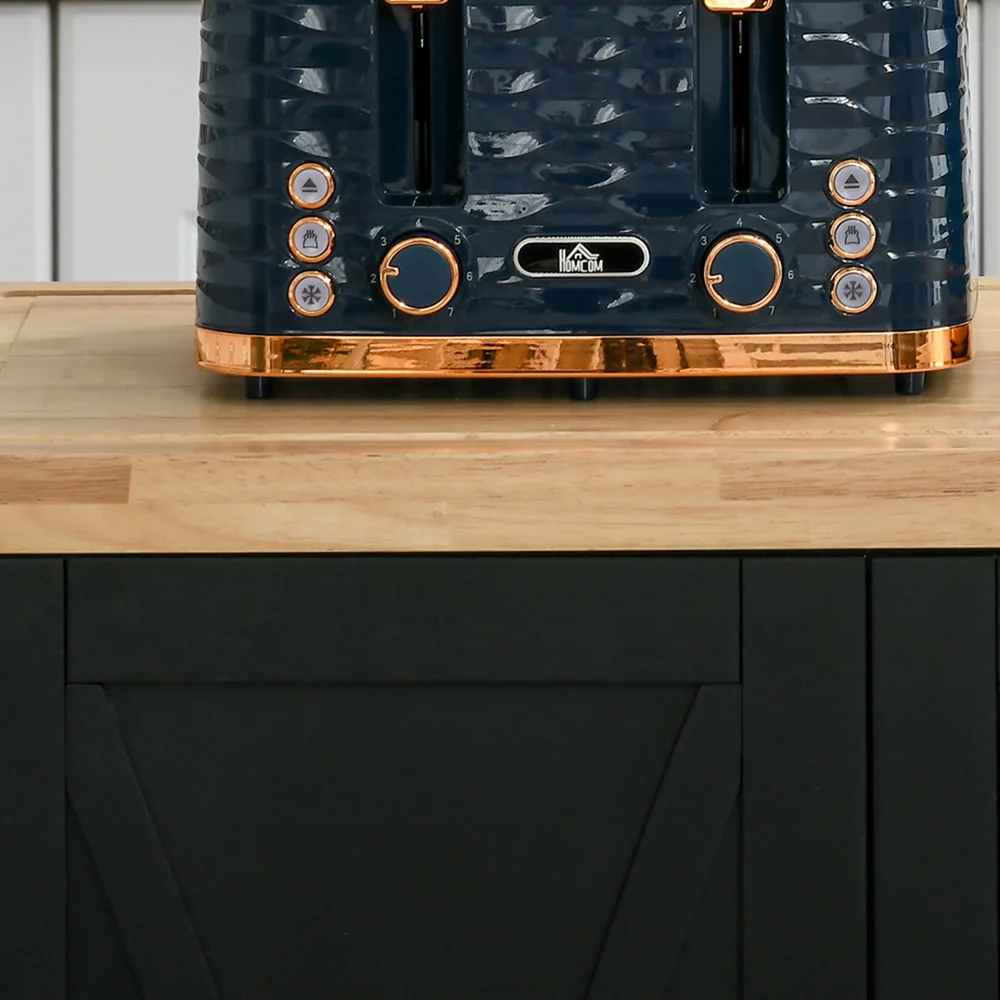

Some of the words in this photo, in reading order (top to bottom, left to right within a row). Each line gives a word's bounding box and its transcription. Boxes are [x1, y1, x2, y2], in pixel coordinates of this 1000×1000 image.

[736, 217, 743, 227] 4
[380, 237, 387, 246] 3
[454, 235, 461, 245] 5
[701, 236, 707, 246] 3
[776, 233, 782, 243] 5
[559, 249, 604, 273] HOMCOM
[370, 274, 376, 283] 2
[466, 272, 473, 281] 6
[690, 274, 696, 283] 2
[788, 270, 794, 279] 6
[448, 307, 454, 317] 7
[769, 306, 775, 316] 7
